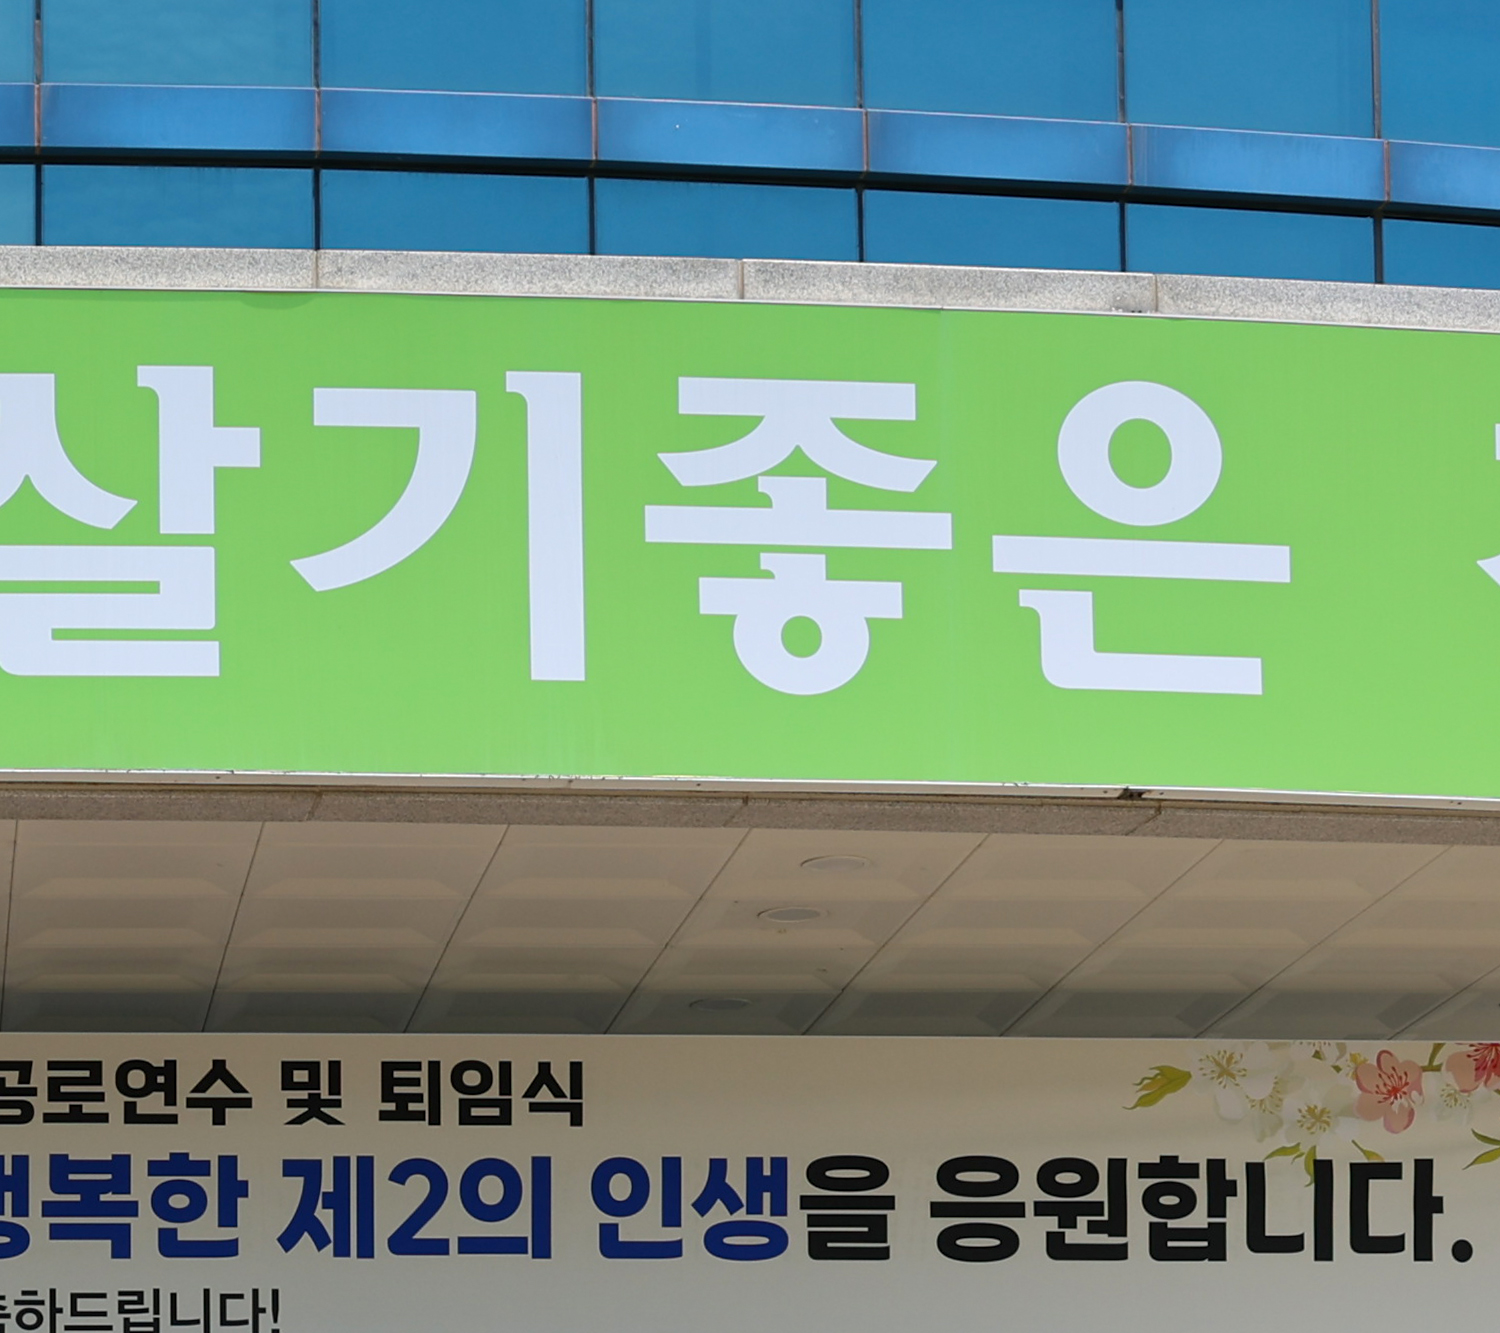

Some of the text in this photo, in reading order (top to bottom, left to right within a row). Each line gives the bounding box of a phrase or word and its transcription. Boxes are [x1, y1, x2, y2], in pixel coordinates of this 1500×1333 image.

[281, 1060, 344, 1125] 및
[379, 1060, 583, 1126] 퇴임식
[277, 1155, 551, 1260] 제2의
[591, 1154, 895, 1262] 인생을
[930, 1156, 1475, 1263] 응원합니다.
